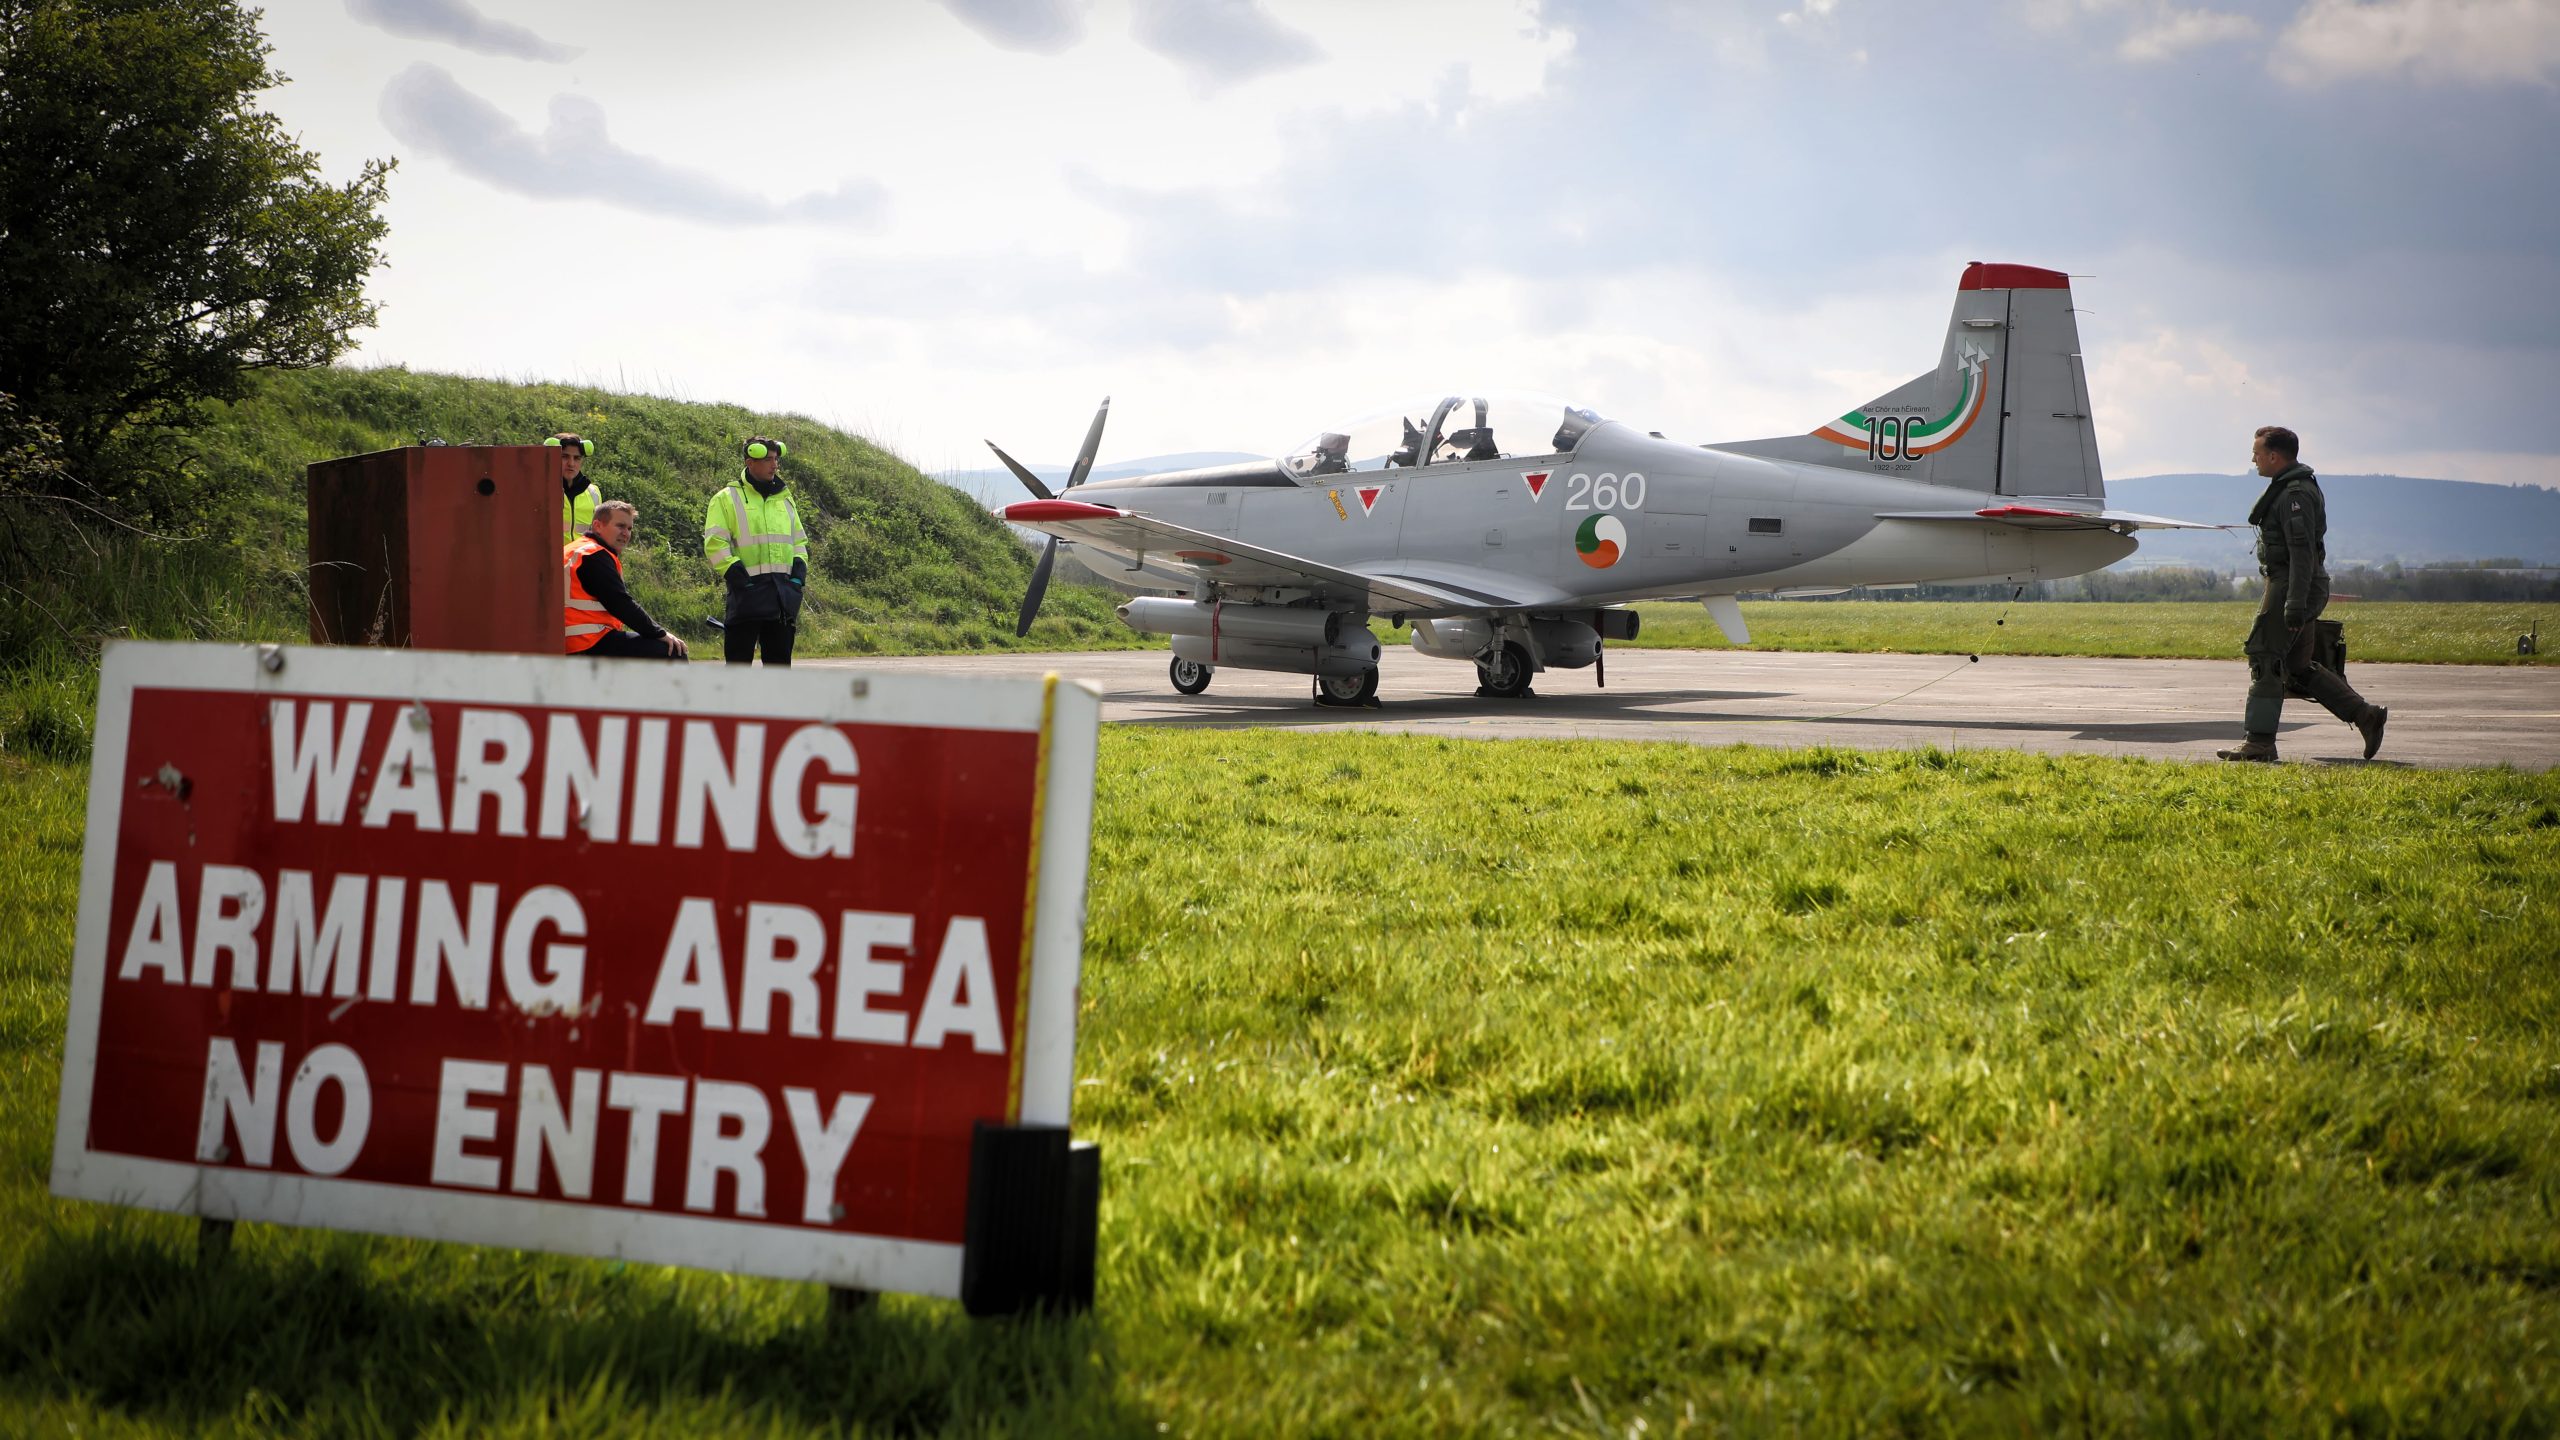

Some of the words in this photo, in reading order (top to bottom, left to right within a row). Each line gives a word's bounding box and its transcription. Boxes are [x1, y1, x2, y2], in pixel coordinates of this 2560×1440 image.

[1863, 405, 1874, 413] Aer
[1565, 472, 1646, 511] 260
[269, 698, 860, 860] WARNING
[118, 859, 589, 1018] ARMING
[642, 896, 1006, 1055] AREA
[195, 1036, 373, 1176] NO
[430, 1056, 876, 1225] ENTRY
